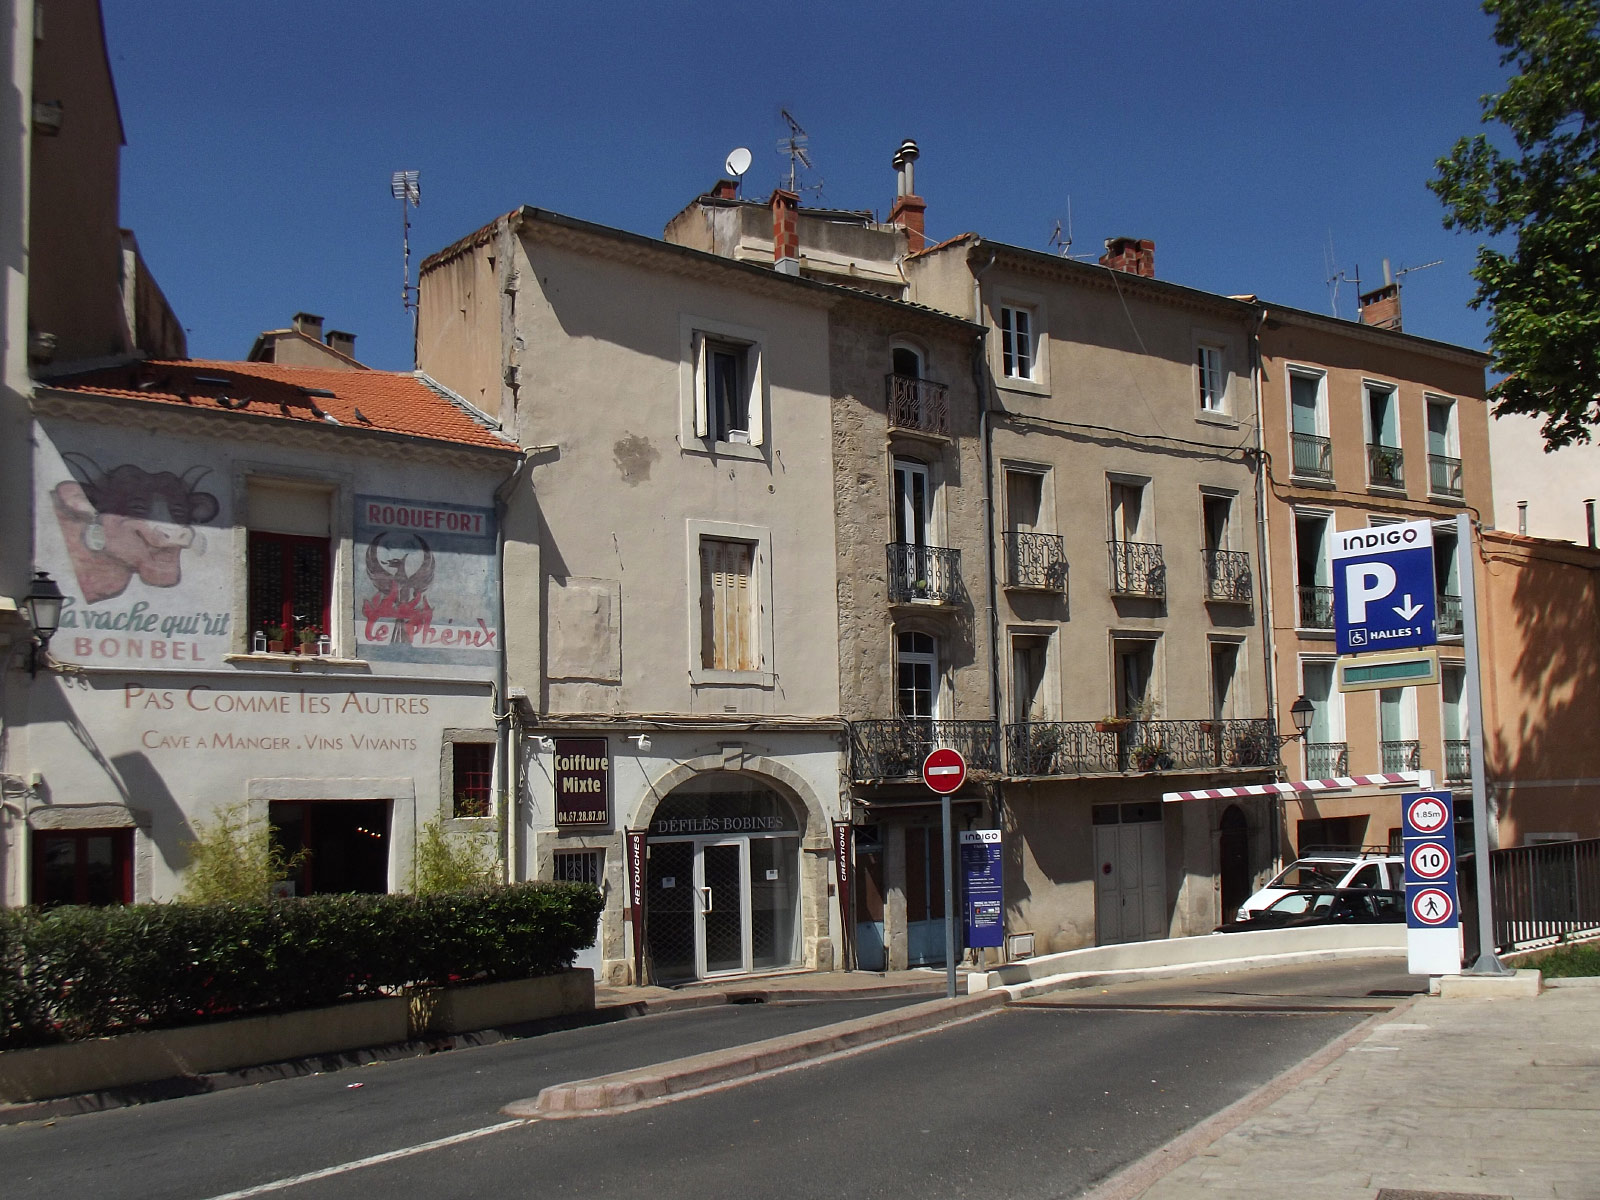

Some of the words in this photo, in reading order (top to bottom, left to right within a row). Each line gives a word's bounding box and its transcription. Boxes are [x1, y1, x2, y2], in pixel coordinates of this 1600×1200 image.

[368, 503, 483, 533] ROQUEFORT
[1343, 529, 1418, 551] INDIGO
[1345, 562, 1397, 624] P
[80, 601, 159, 633] vache
[1370, 627, 1412, 640] HALLES
[1415, 627, 1421, 635] 1
[74, 636, 206, 662] BONBEL
[124, 682, 174, 710] PAS
[187, 685, 291, 714] COMME
[341, 690, 430, 715] AUTRES
[142, 730, 191, 749] CAVE
[196, 735, 207, 749] A
[212, 732, 290, 750] MANGER
[304, 734, 343, 750] VINS
[351, 734, 417, 751] VIVANTS
[554, 754, 609, 771] Coiffure
[563, 776, 601, 793] Mixte
[558, 810, 606, 822] 04.67.28.87.01
[658, 815, 720, 833] DÉFILÉS
[724, 816, 784, 830] BOBINES
[1416, 811, 1441, 819] 1.85m
[965, 833, 998, 841] INDIGO
[839, 827, 847, 882] CRÉATIONS
[1419, 854, 1440, 868] 10
[633, 835, 641, 905] RETOUCHES
